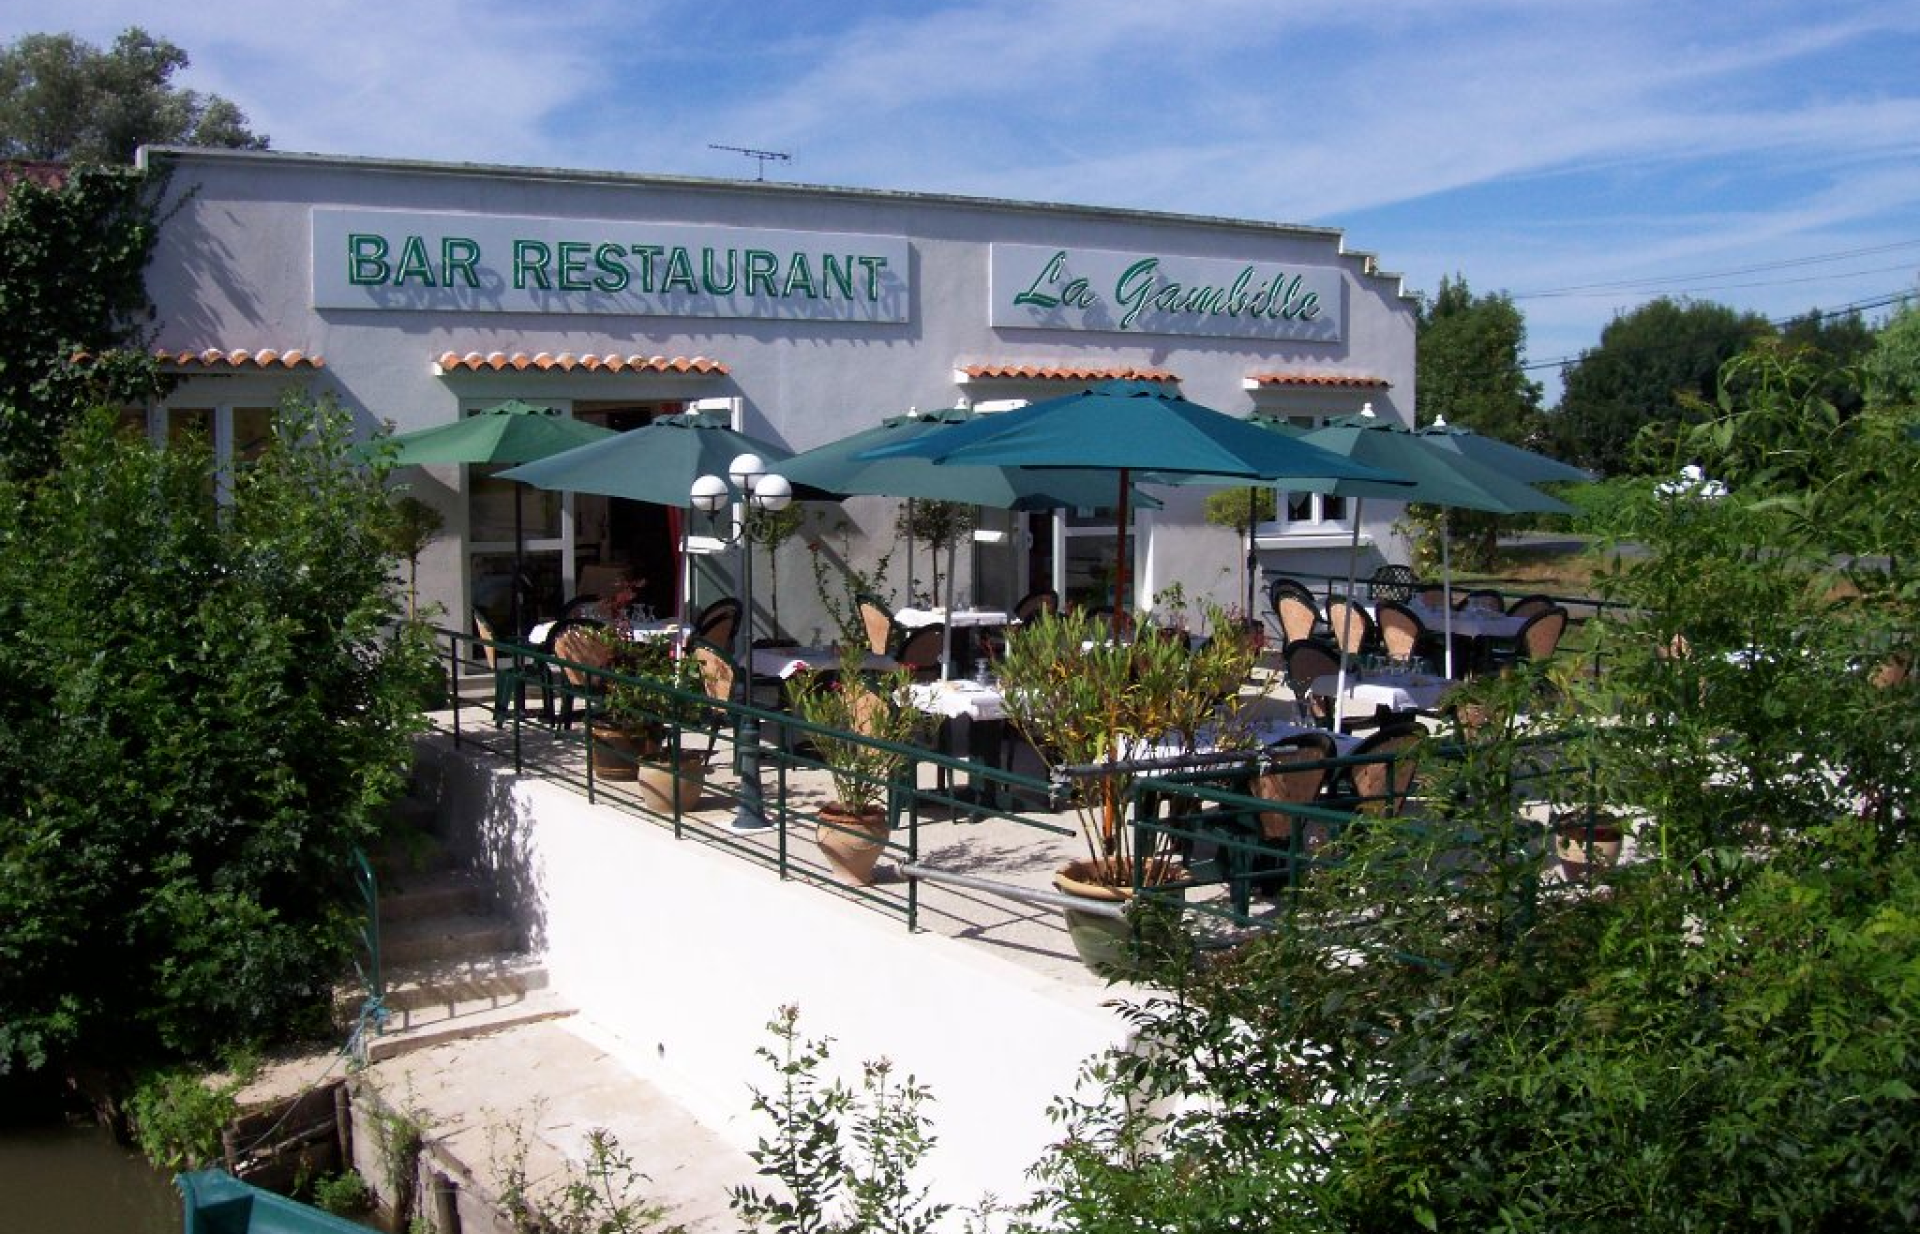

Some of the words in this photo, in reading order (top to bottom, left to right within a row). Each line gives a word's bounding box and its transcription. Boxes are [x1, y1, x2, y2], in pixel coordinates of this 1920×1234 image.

[348, 233, 482, 288] BAR
[513, 239, 888, 301] RESTAURANT
[1013, 250, 1098, 308] La
[1115, 257, 1321, 330] Gambille
